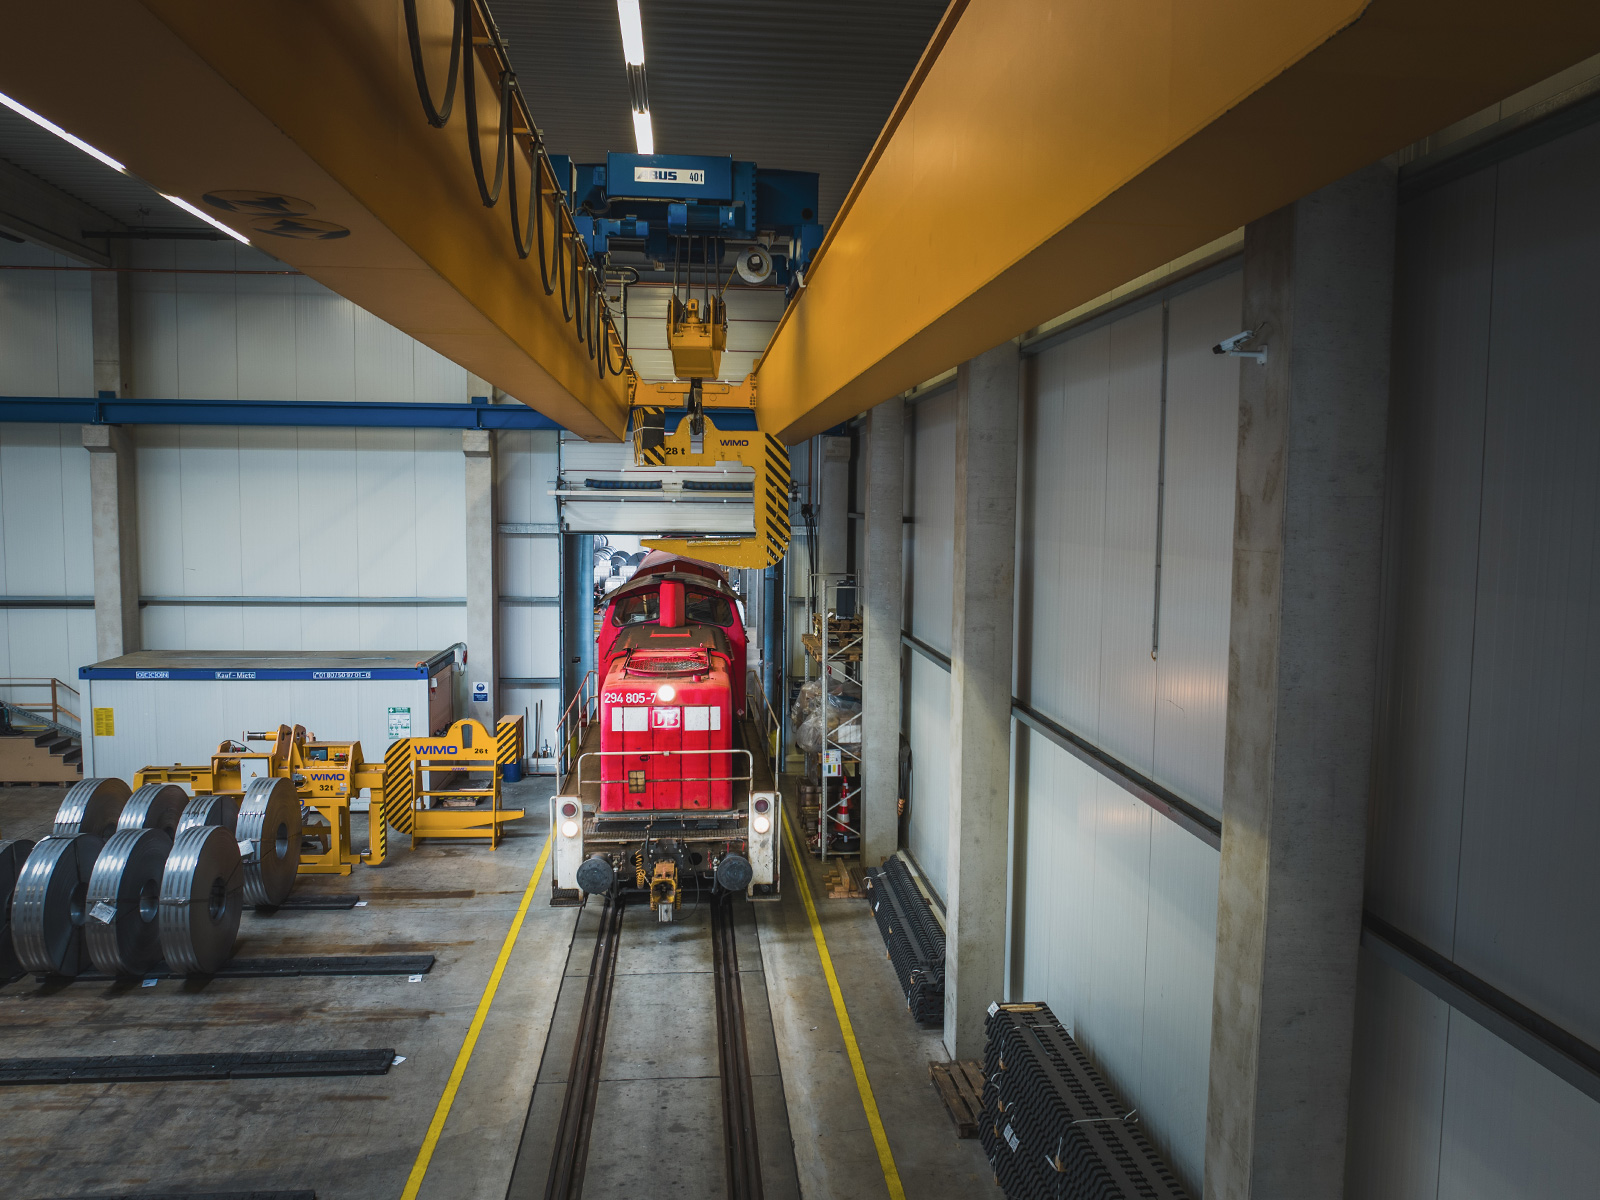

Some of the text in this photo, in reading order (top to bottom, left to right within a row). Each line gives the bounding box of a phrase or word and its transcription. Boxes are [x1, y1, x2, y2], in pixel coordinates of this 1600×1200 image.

[665, 447, 678, 455] 28
[604, 692, 658, 704] 294 805-7
[653, 711, 679, 727] DB
[413, 745, 458, 755] WIMO
[310, 773, 345, 781] WIMO
